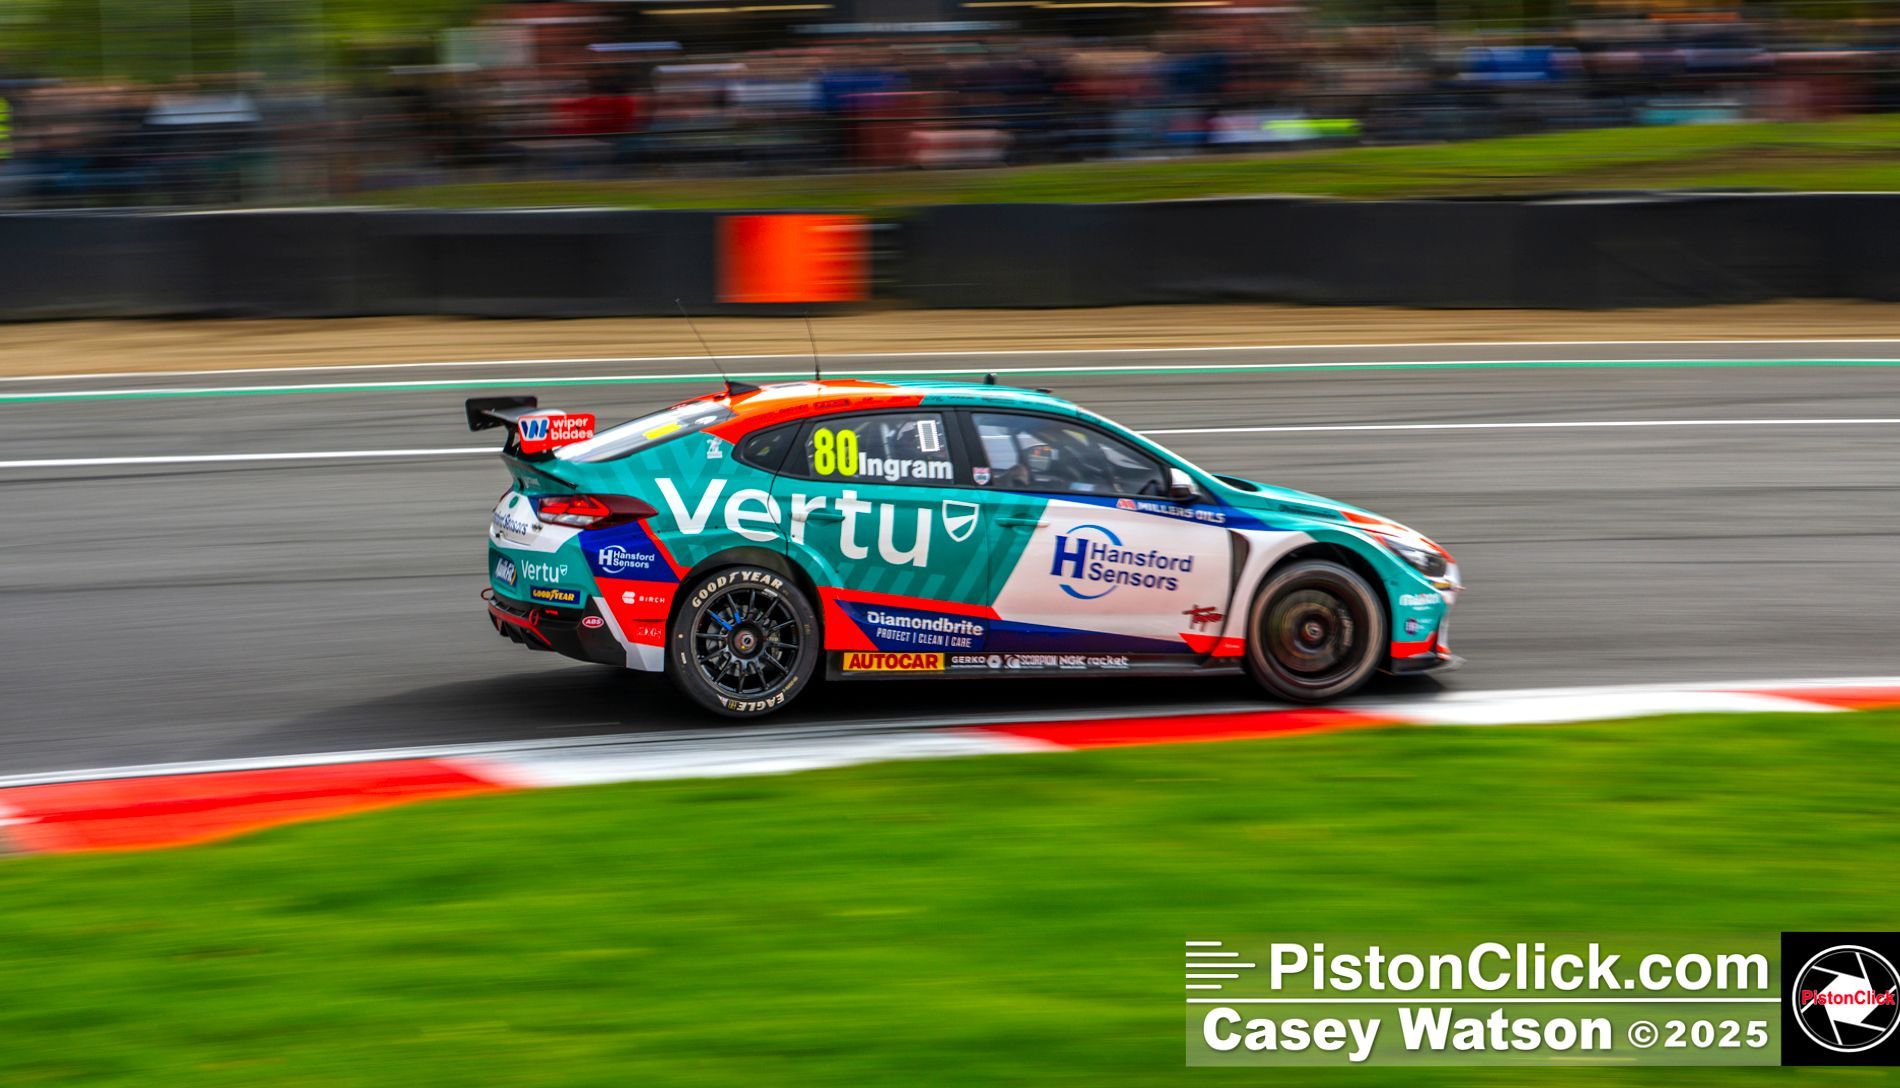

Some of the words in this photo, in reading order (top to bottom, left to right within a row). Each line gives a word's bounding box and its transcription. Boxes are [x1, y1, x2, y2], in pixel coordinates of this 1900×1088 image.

[553, 417, 589, 430] wiper
[551, 427, 594, 440] blades
[813, 427, 859, 477] 80
[859, 452, 955, 481] Ingram
[1137, 501, 1195, 519] MILLERS
[1195, 509, 1226, 524] OILS
[654, 477, 933, 568] Vertu
[613, 550, 656, 562] Hansford
[613, 558, 650, 569] Sensors
[1090, 542, 1195, 573] Hansford
[521, 559, 560, 583] Vertu
[1088, 562, 1179, 592] Sensors
[532, 588, 575, 601] GOODYEAR
[691, 570, 784, 608] GOODYEAR
[638, 595, 666, 604] BIRCH
[585, 617, 602, 626] ABS
[866, 611, 985, 636] Diamondbrite
[876, 627, 911, 643] PROTECT
[918, 633, 944, 646] CLEAN
[951, 636, 973, 648] CARE
[848, 653, 939, 670] AUTOCAR
[951, 655, 987, 664] GERKO
[1020, 654, 1058, 666] SCORPION
[1059, 655, 1087, 666] NGK
[1087, 655, 1130, 666] rocket
[736, 691, 785, 712] EAGLE
